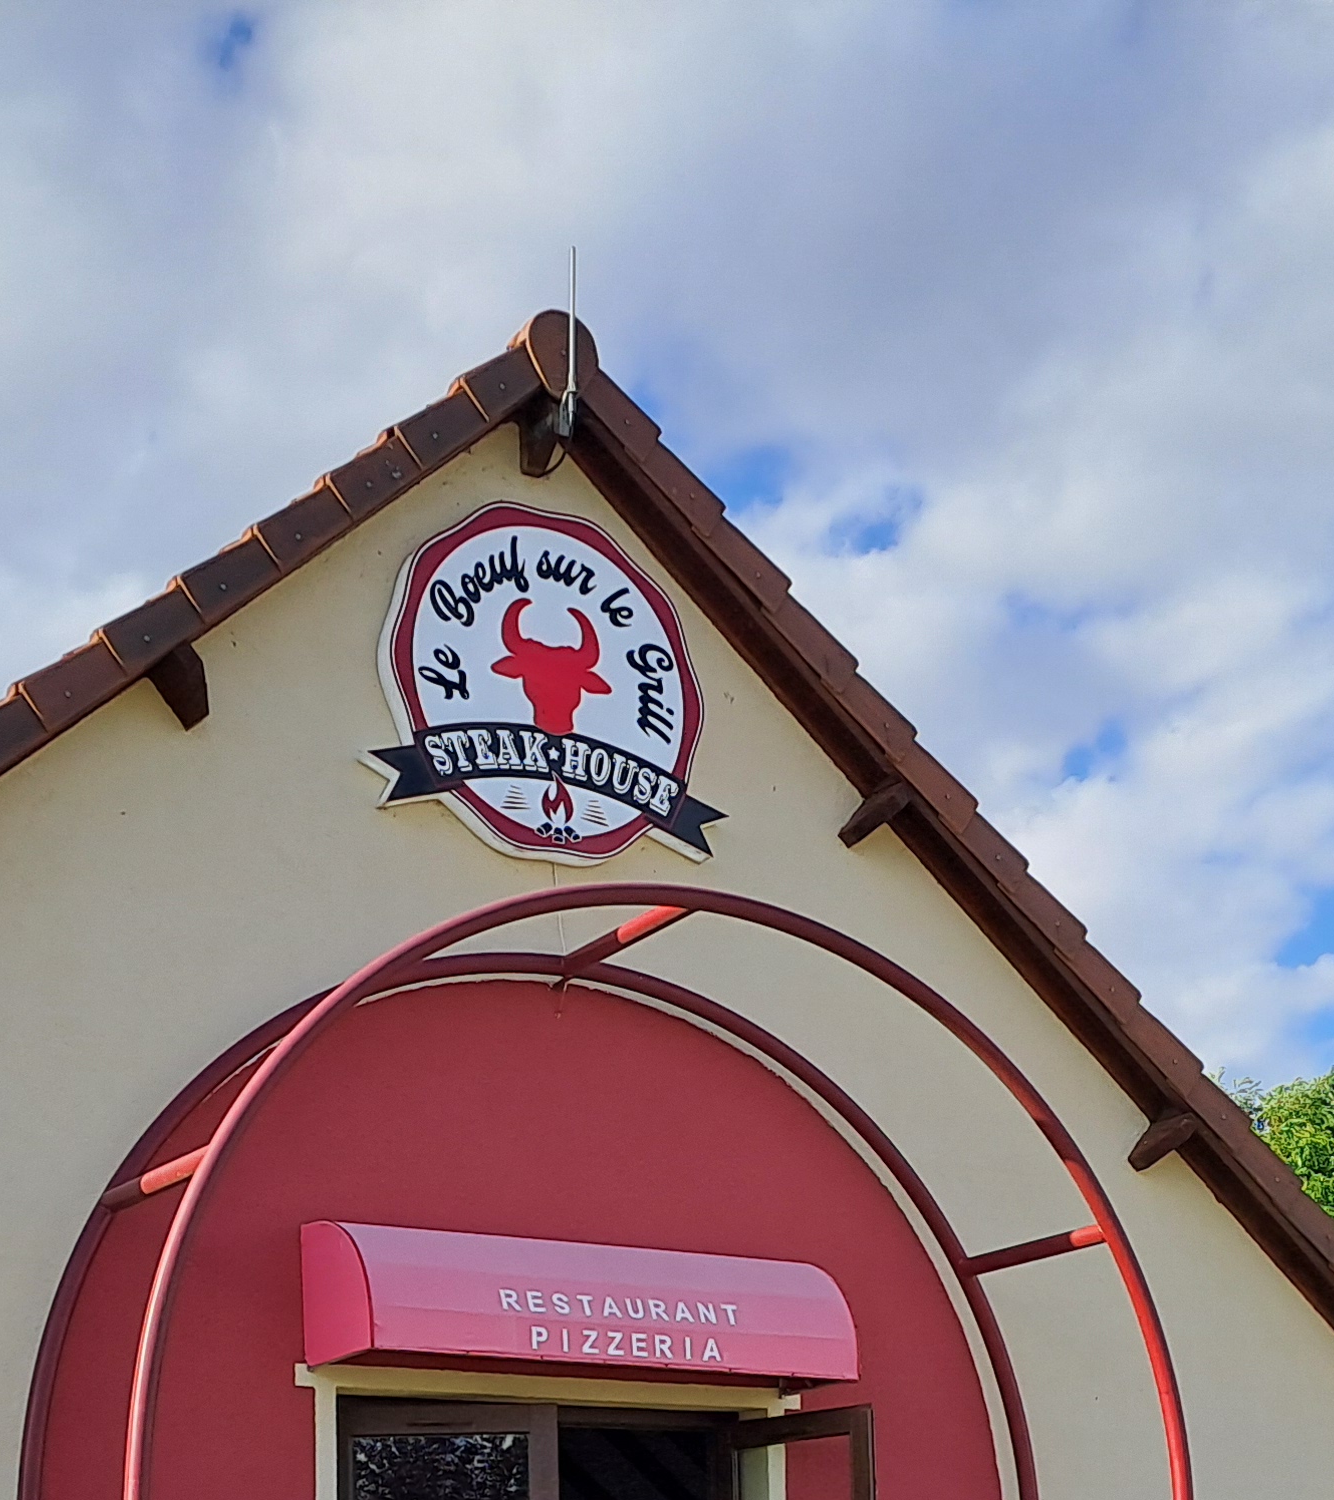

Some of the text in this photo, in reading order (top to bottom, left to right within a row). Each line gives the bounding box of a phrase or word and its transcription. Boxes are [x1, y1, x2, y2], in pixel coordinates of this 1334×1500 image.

[418, 535, 674, 744] Le Boeuf sur le Grill
[424, 729, 678, 817] STEAK HOUSE
[499, 1288, 737, 1326] RESTAURANT
[530, 1325, 722, 1363] PIZZERIA
